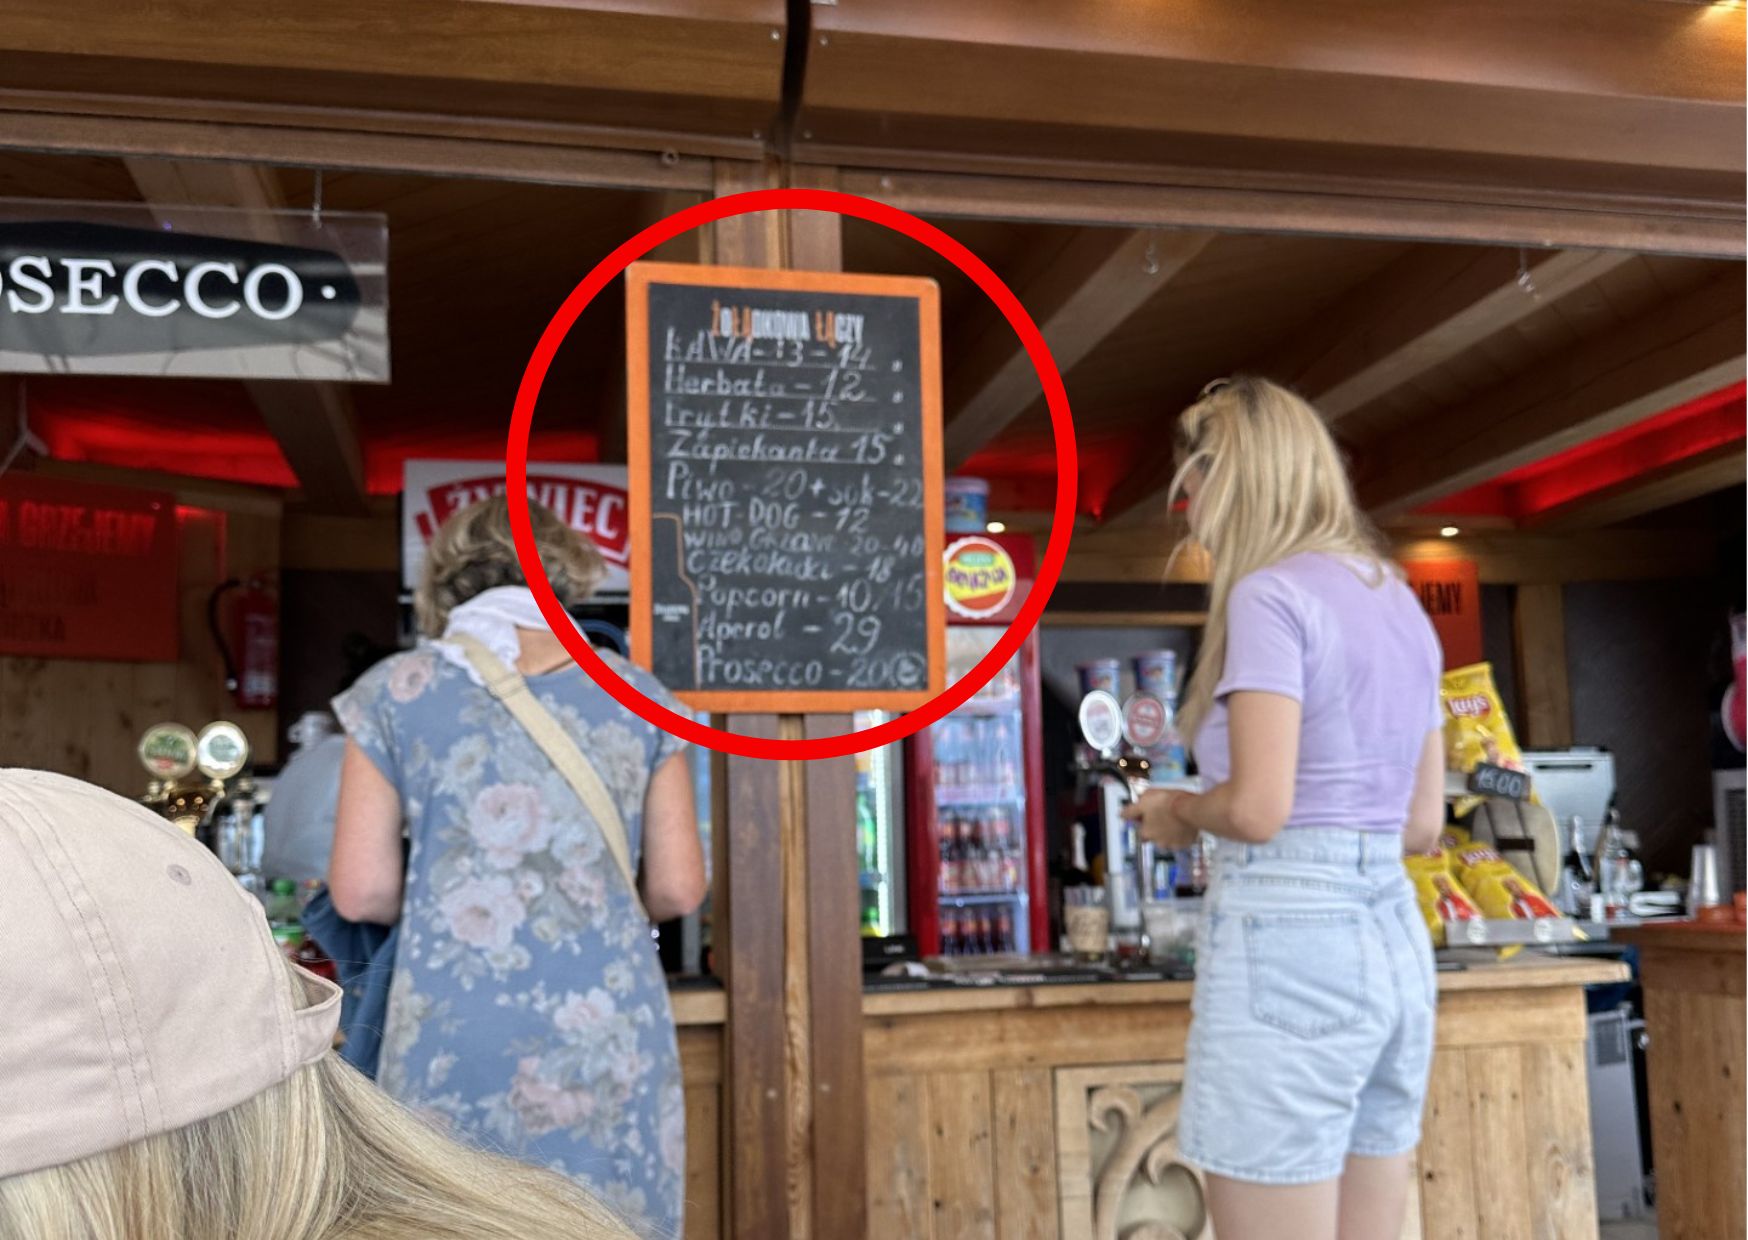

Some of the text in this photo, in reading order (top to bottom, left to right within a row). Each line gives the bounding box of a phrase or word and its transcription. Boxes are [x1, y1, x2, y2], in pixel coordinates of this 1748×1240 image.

[0, 254, 304, 321] SECCO
[664, 361, 788, 398] Herbata
[666, 459, 735, 500] Piwo
[835, 506, 872, 534] 12
[697, 573, 810, 618] Popcorn
[698, 608, 786, 652] Aperol
[829, 611, 883, 655] 29
[698, 644, 823, 685] Prosecco
